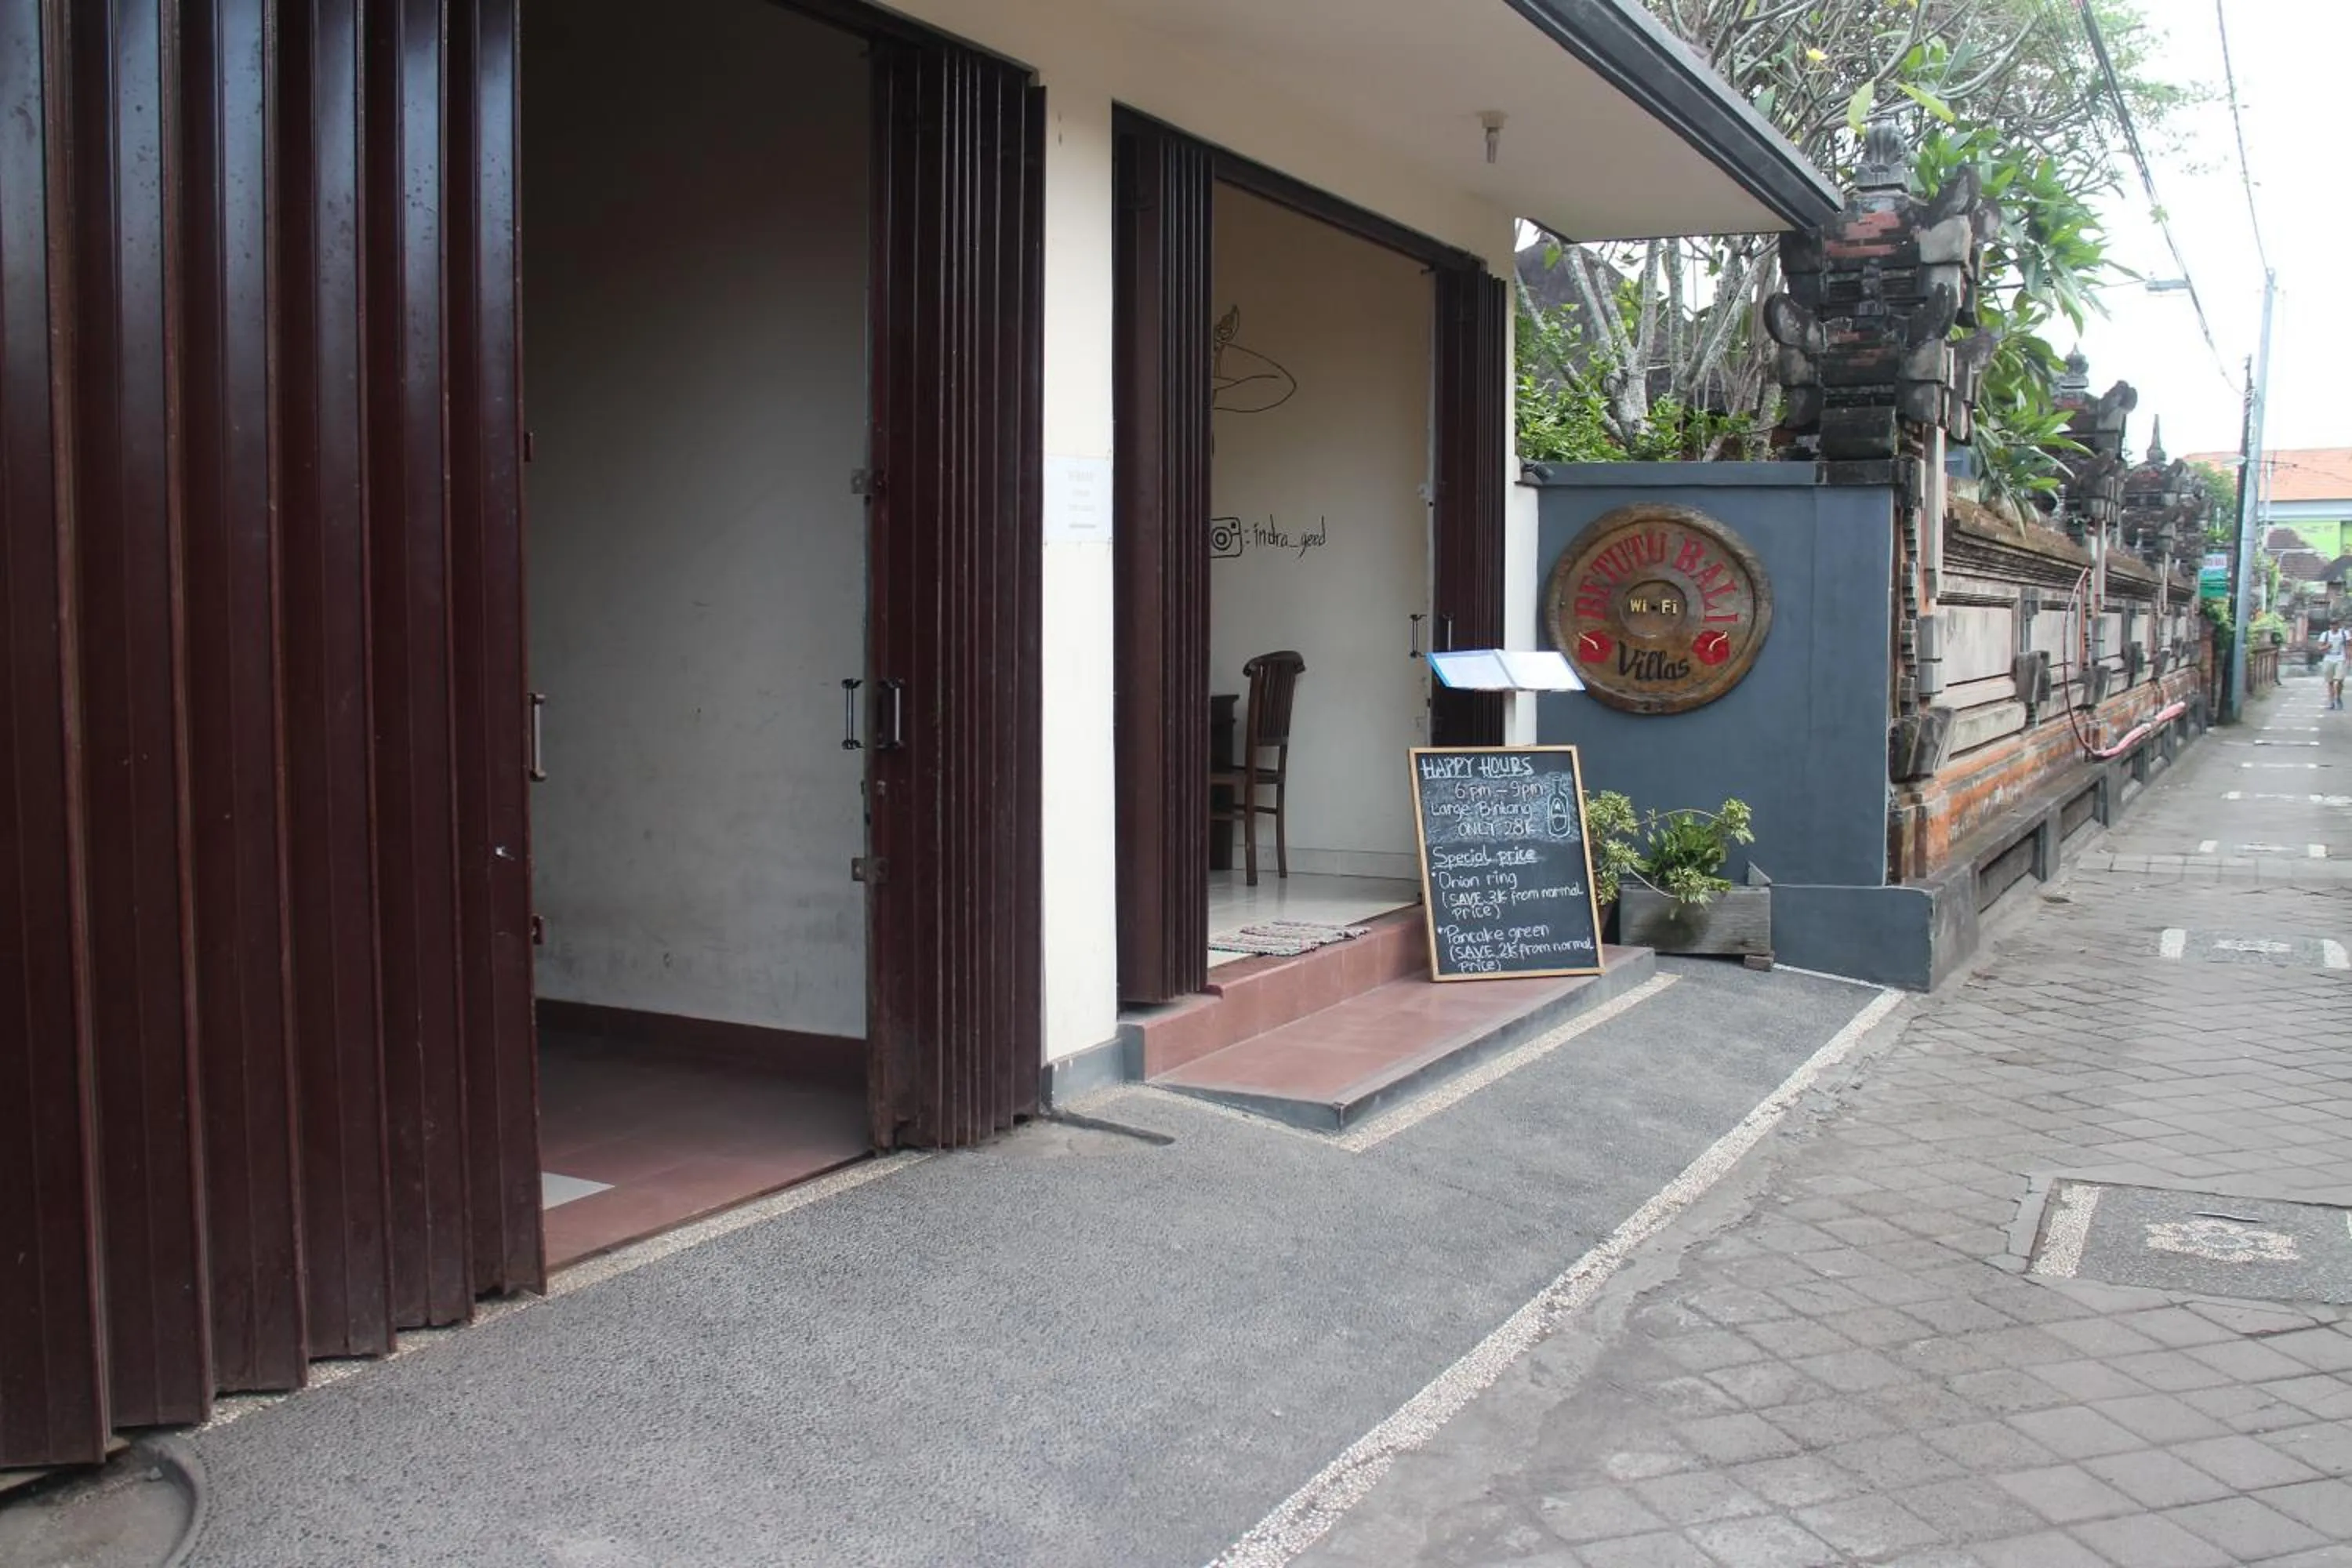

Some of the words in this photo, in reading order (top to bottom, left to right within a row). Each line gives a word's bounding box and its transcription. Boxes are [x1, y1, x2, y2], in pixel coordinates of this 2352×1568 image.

[1573, 530, 1668, 620] BETUTU
[1673, 535, 1739, 622] BALI
[1617, 640, 1690, 681] Villas
[1421, 756, 1475, 779] HAPPY
[1479, 756, 1534, 778] HOURS
[1431, 800, 1471, 822] Large
[1457, 822, 1496, 837] ONLY
[1432, 844, 1490, 868] Special
[1497, 846, 1537, 866] price
[1486, 870, 1518, 889] ring
[1511, 888, 1539, 906] from
[1541, 881, 1584, 898] normal
[1451, 904, 1501, 920] price)
[1508, 924, 1550, 943] green
[1519, 942, 1551, 961] from
[1552, 936, 1594, 951] normal
[1457, 960, 1502, 972] price)
